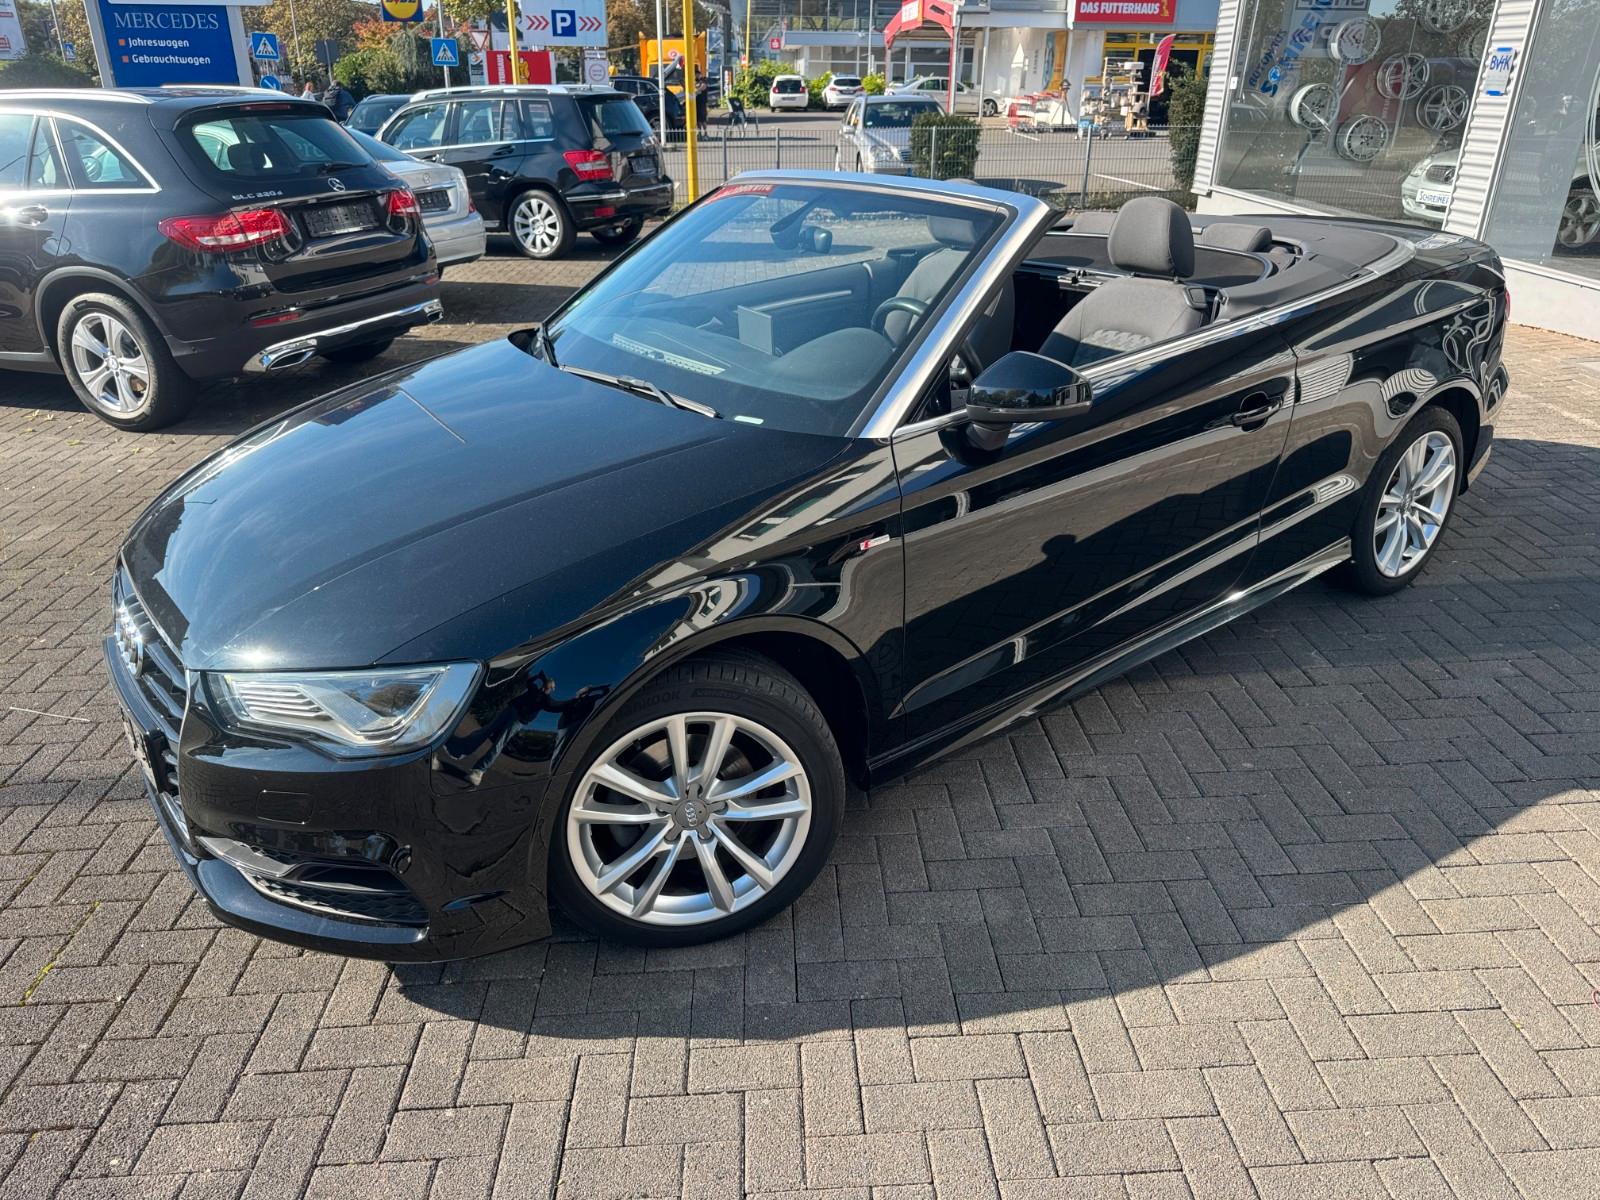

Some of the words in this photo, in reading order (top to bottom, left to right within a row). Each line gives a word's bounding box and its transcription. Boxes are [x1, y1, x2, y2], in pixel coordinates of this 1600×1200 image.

[1080, 2, 1100, 13] DAS
[1101, 3, 1160, 14] FUTTERHAUS
[113, 12, 219, 29] MERCEDES
[555, 13, 571, 34] P
[128, 37, 190, 48] Jahreswagen
[132, 54, 211, 65] Gebrauchtwagen
